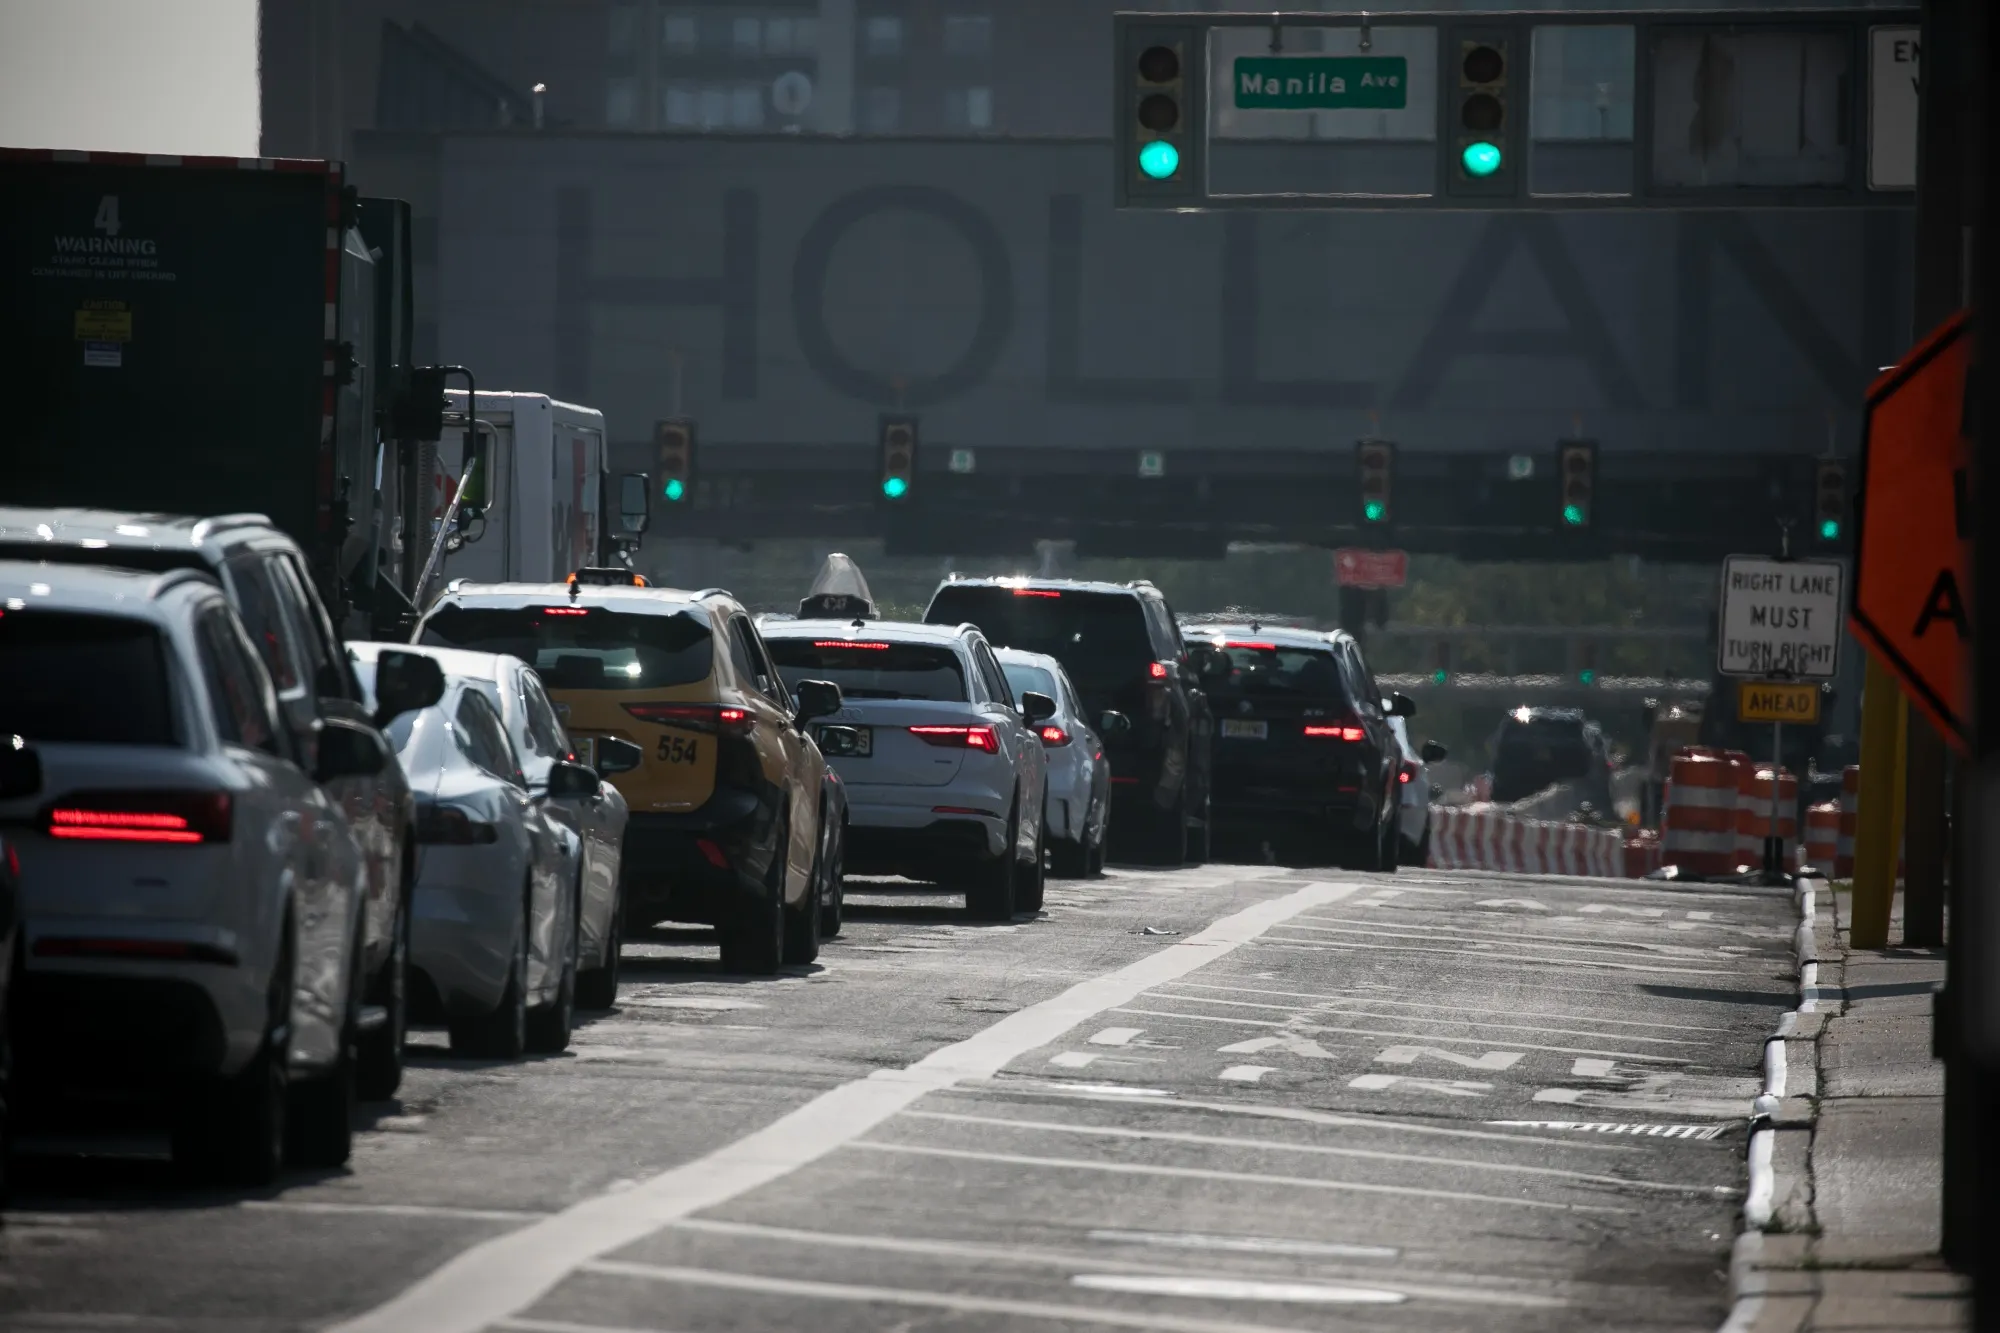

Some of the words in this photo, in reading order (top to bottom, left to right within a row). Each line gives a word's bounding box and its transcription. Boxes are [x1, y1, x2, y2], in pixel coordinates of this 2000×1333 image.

[1240, 72, 1345, 95] Manila
[1361, 72, 1399, 87] Ave
[94, 194, 121, 235] 4
[54, 236, 156, 255] WARNING
[89, 256, 124, 267] CLEAR
[1732, 571, 1783, 593] RIGHT
[1790, 573, 1834, 596] LANE
[1750, 603, 1812, 630] MUST
[1728, 638, 1772, 660] TURN
[1780, 641, 1831, 663] RIGHT
[1748, 691, 1810, 714] AHEAD
[657, 735, 698, 765] 554
